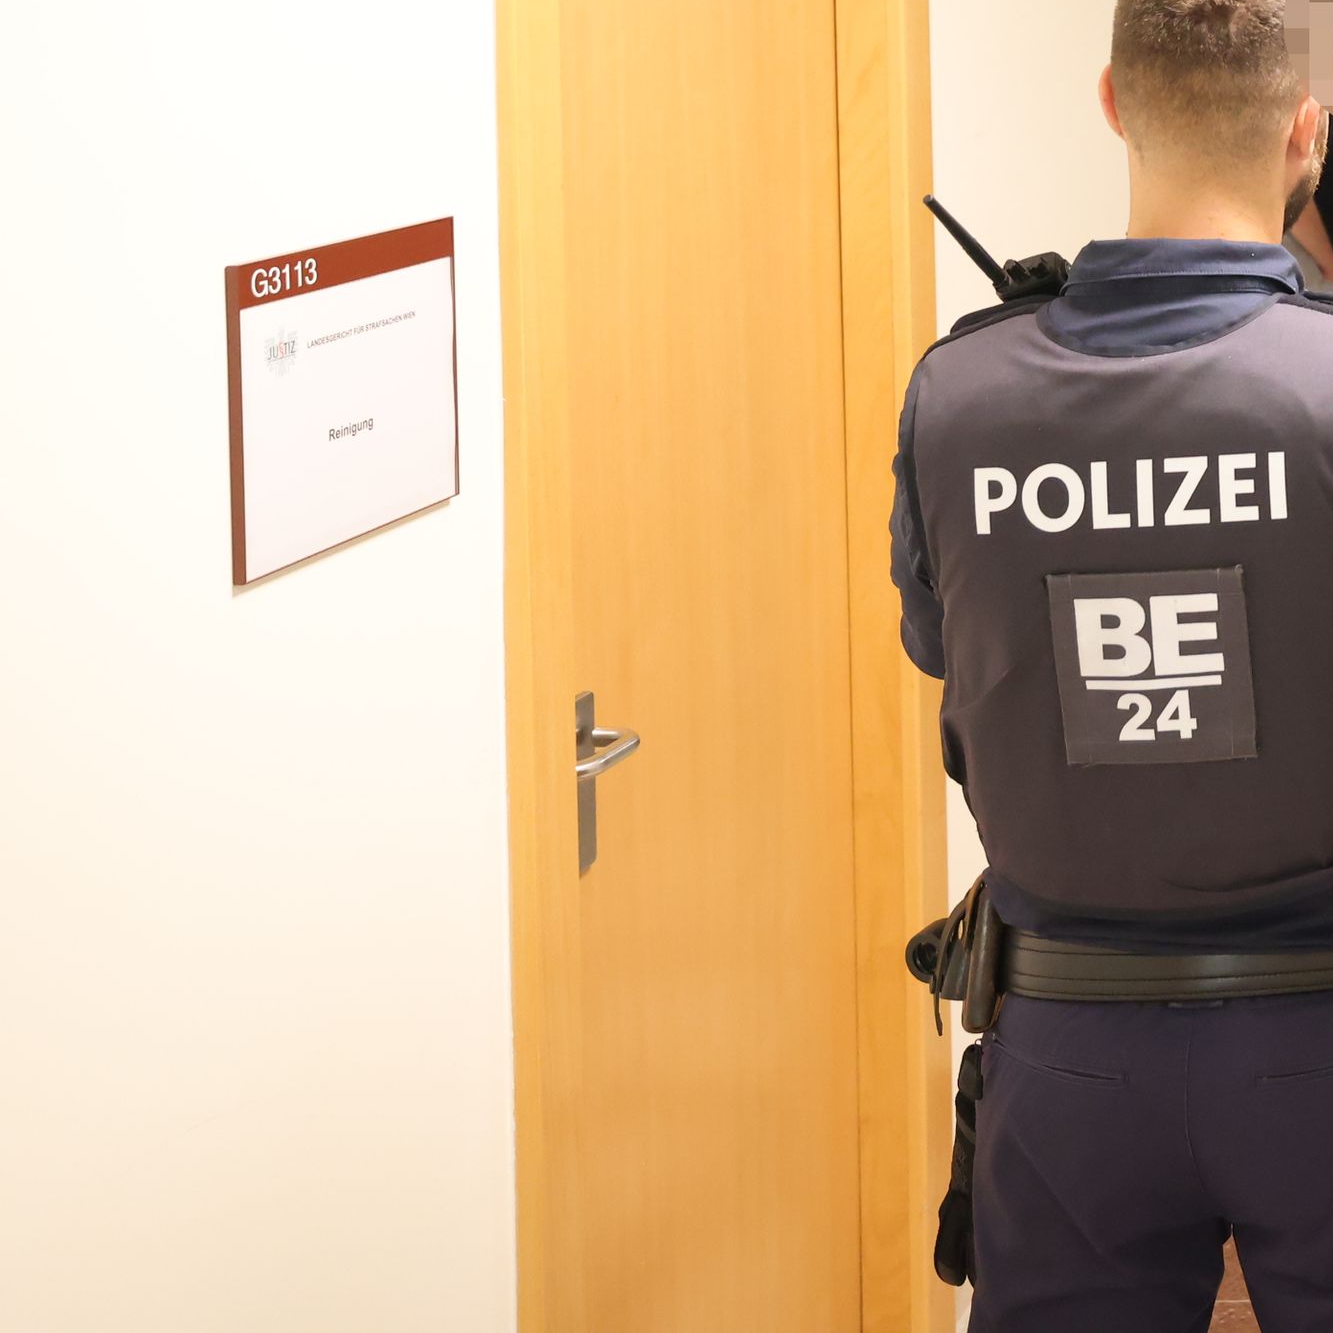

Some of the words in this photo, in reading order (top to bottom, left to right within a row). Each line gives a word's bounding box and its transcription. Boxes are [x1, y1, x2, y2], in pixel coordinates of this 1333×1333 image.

[251, 258, 317, 298] G3113
[307, 329, 353, 349] LANDESGERICHT
[353, 325, 364, 335] FÜR
[365, 315, 402, 332] STRAFSACHEN
[403, 311, 416, 321] WIEN
[328, 418, 374, 442] Reinigung
[974, 452, 1289, 535] POLIZEI
[1073, 593, 1225, 678] BE
[1116, 693, 1197, 742] 24
